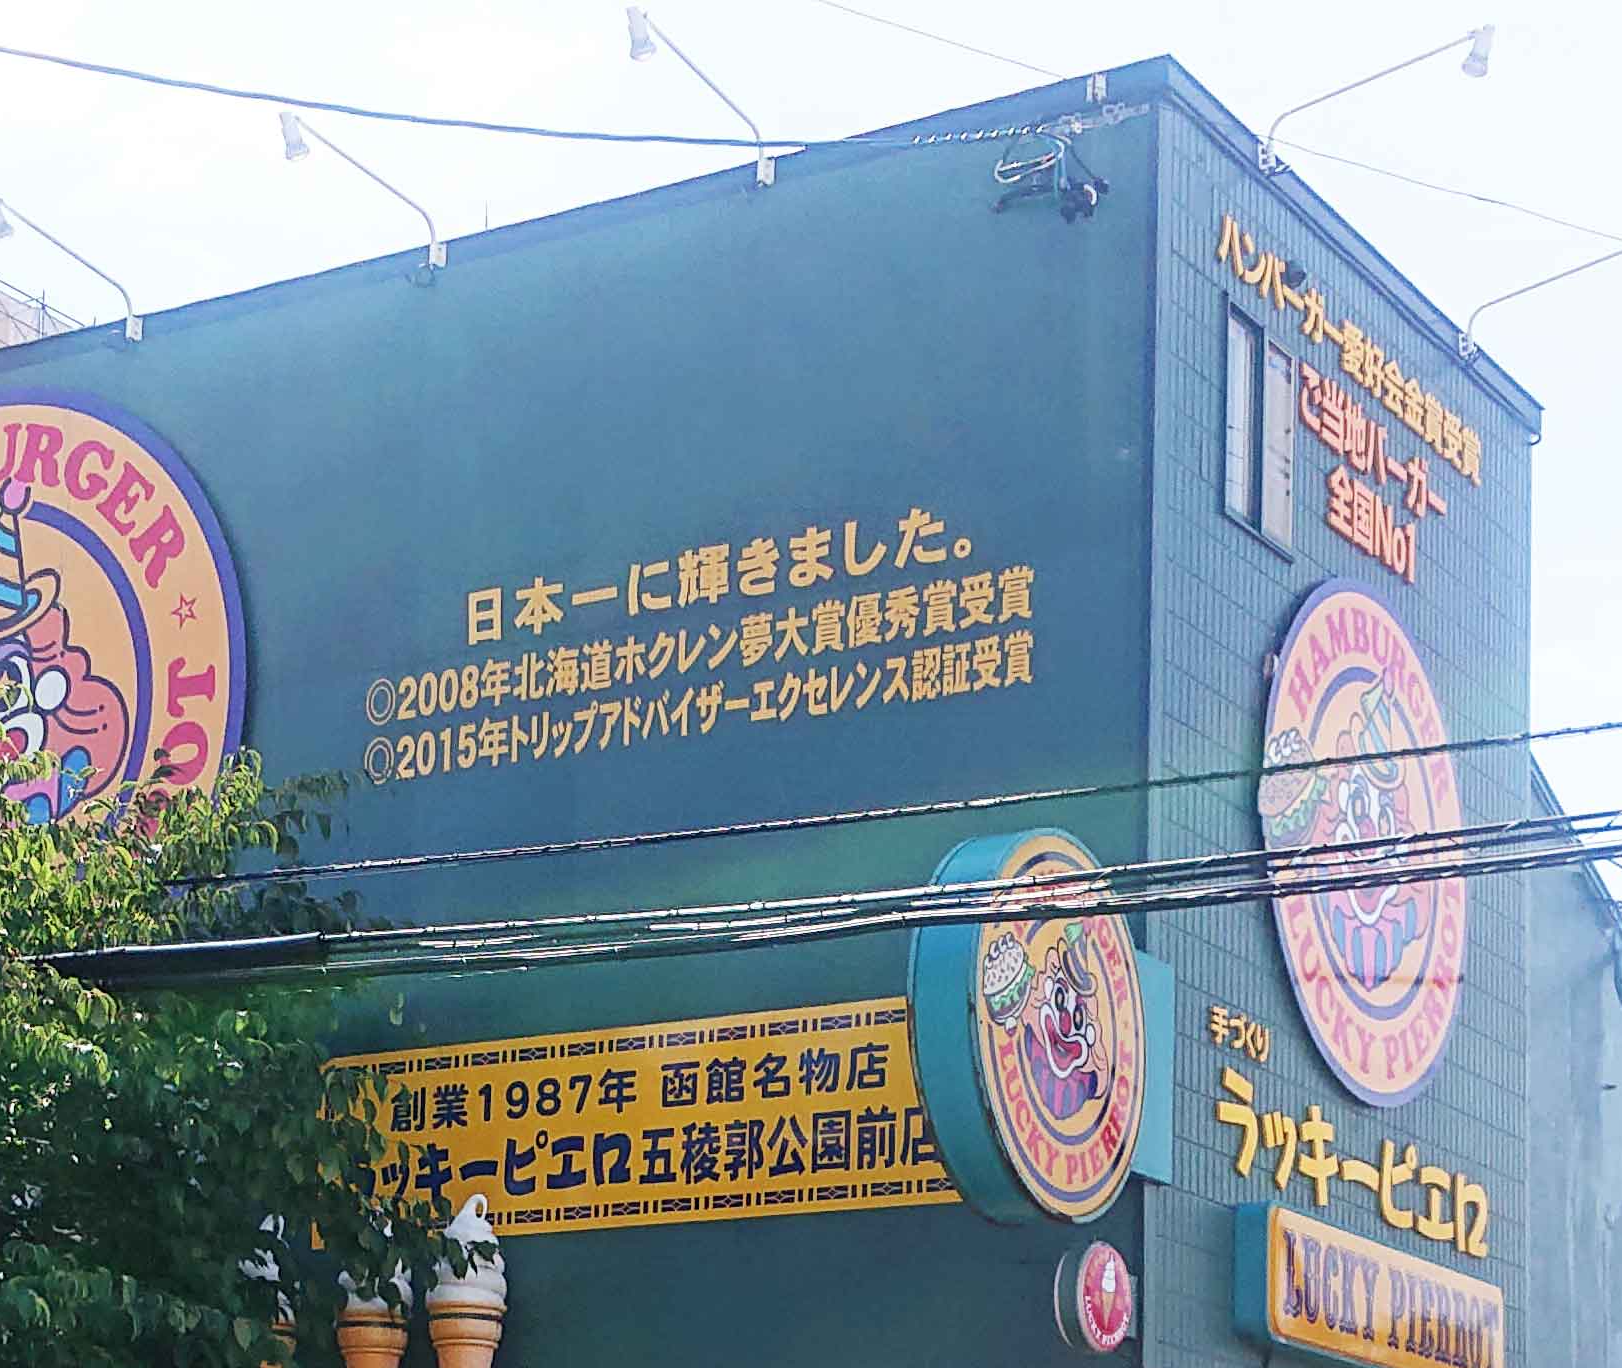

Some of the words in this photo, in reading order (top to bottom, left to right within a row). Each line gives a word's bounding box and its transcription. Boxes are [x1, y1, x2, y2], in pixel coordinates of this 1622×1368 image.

[467, 507, 973, 645] 日本一に輝きました。
[1325, 463, 1417, 584] 全国No1
[1287, 606, 1448, 808] HAMBURGER
[1209, 1003, 1272, 1063] 手づくり
[1286, 896, 1375, 1080] LUCKY
[390, 1067, 637, 1133] 創業1987年
[660, 1041, 890, 1107] 函館名物店
[997, 1040, 1060, 1177] LUCKY
[1064, 1047, 1133, 1186] PIERROT
[1216, 1066, 1489, 1258] ラッキーピエロ
[1084, 1295, 1103, 1343] LUCKY
[1282, 1227, 1379, 1343] LUCKY
